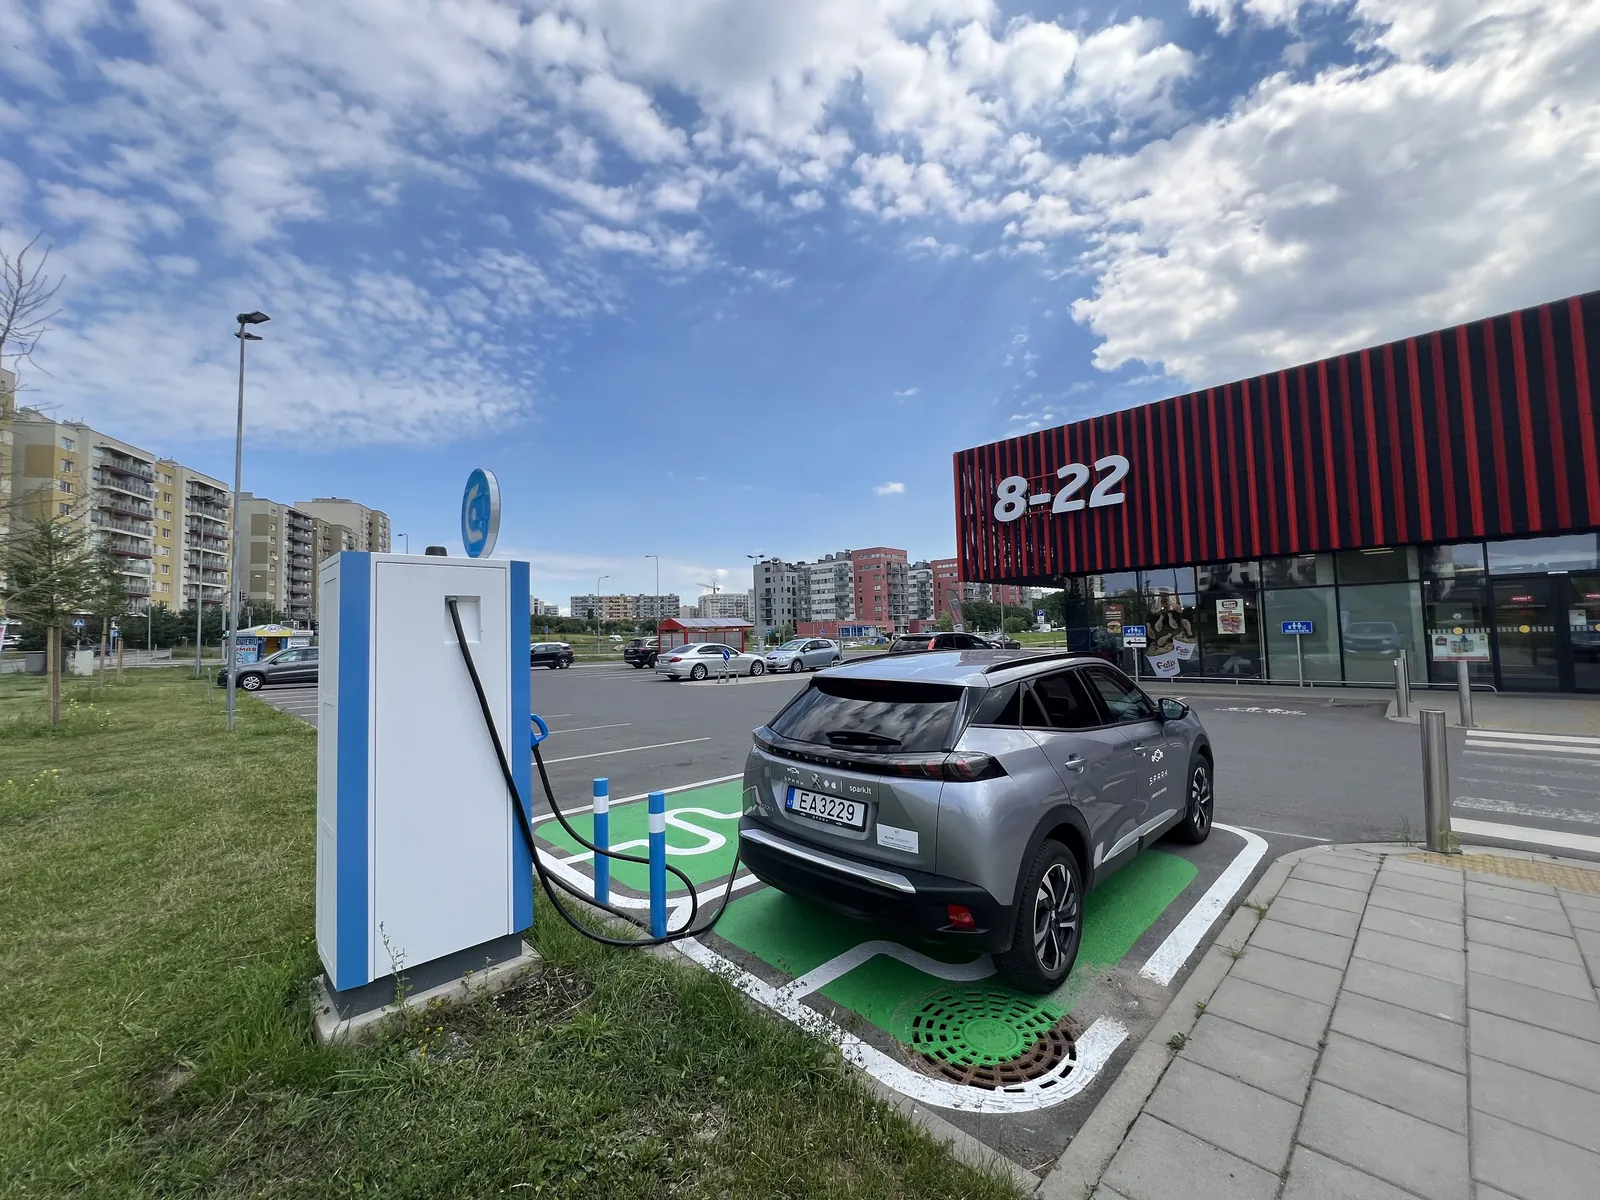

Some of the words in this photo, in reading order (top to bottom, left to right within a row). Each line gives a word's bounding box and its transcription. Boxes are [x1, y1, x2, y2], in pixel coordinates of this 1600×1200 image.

[994, 455, 1130, 522] 8-22
[787, 751, 853, 767] PEUGEOT
[849, 785, 872, 795] spark.lt
[799, 792, 855, 822] EA3229
